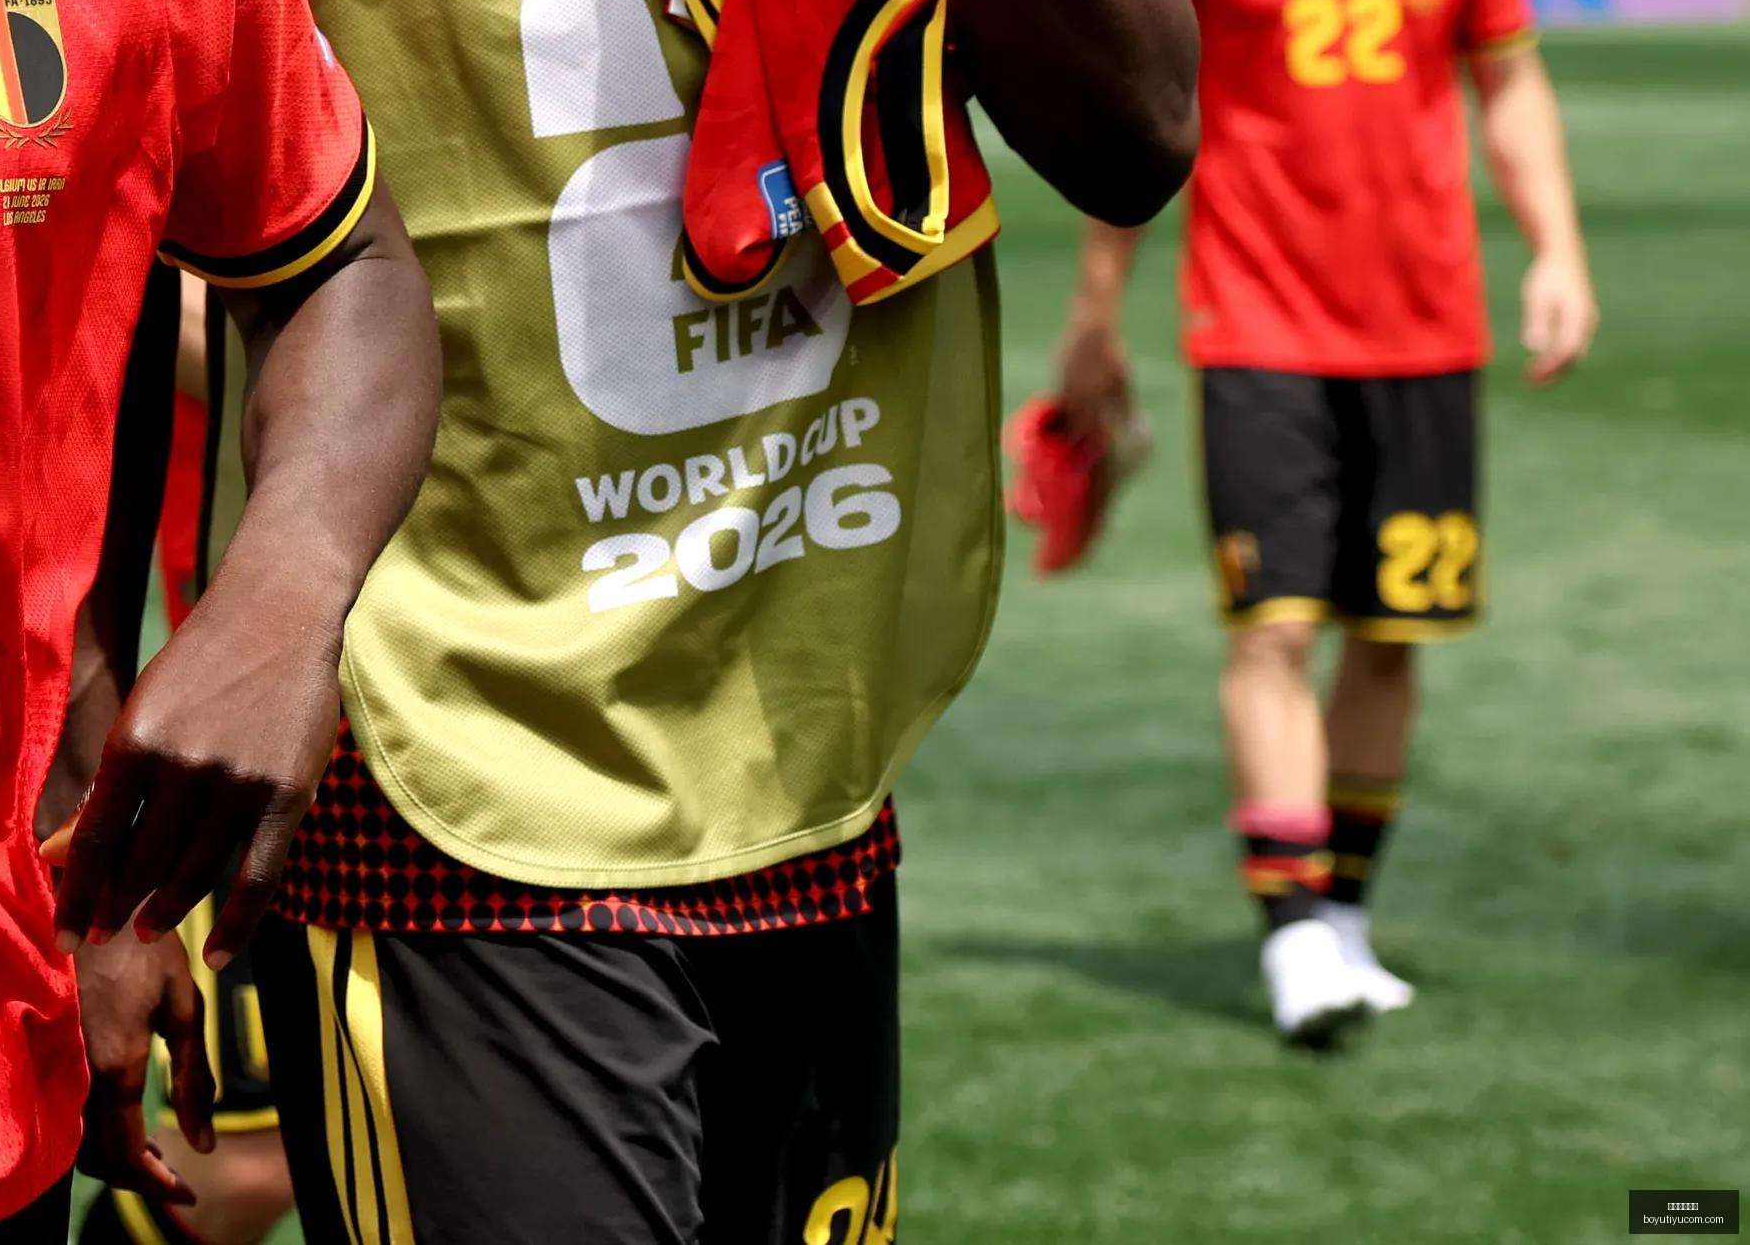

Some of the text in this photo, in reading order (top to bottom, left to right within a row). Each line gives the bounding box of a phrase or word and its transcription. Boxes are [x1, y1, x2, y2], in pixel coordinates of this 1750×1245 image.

[11, 195, 30, 208] JUNE
[14, 210, 46, 224] ANGELES
[672, 285, 824, 374] FIFA
[575, 396, 881, 523] WORLD CUP
[581, 462, 902, 614] 2026
[1376, 511, 1479, 613] 22
